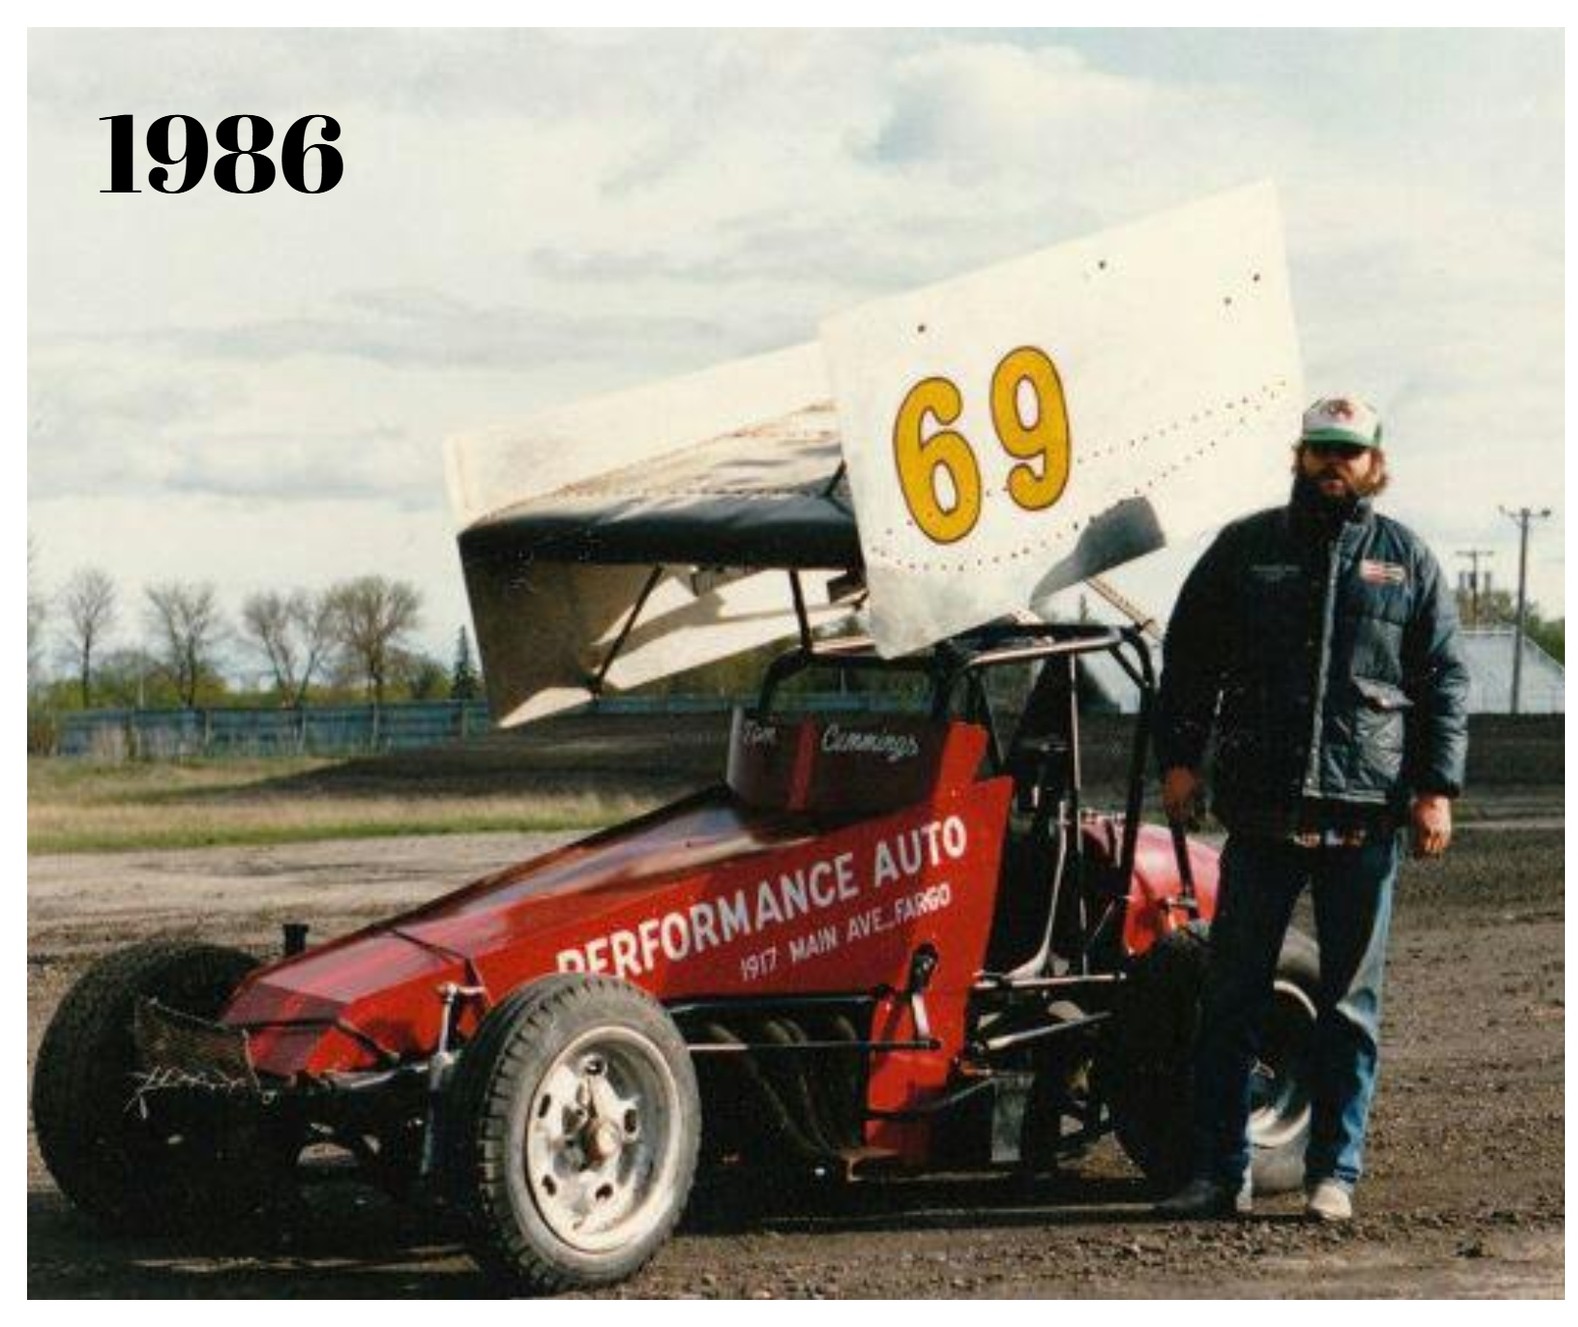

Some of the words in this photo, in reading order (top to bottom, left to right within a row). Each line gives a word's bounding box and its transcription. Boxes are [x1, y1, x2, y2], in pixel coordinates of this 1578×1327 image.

[892, 345, 1071, 545] 69
[822, 723, 920, 763] Cummings
[556, 852, 860, 979] PERFORMANCE
[873, 815, 967, 888] AUTO
[740, 947, 777, 982] 1917
[789, 925, 838, 964] MAIN
[894, 881, 951, 921] FARGO
